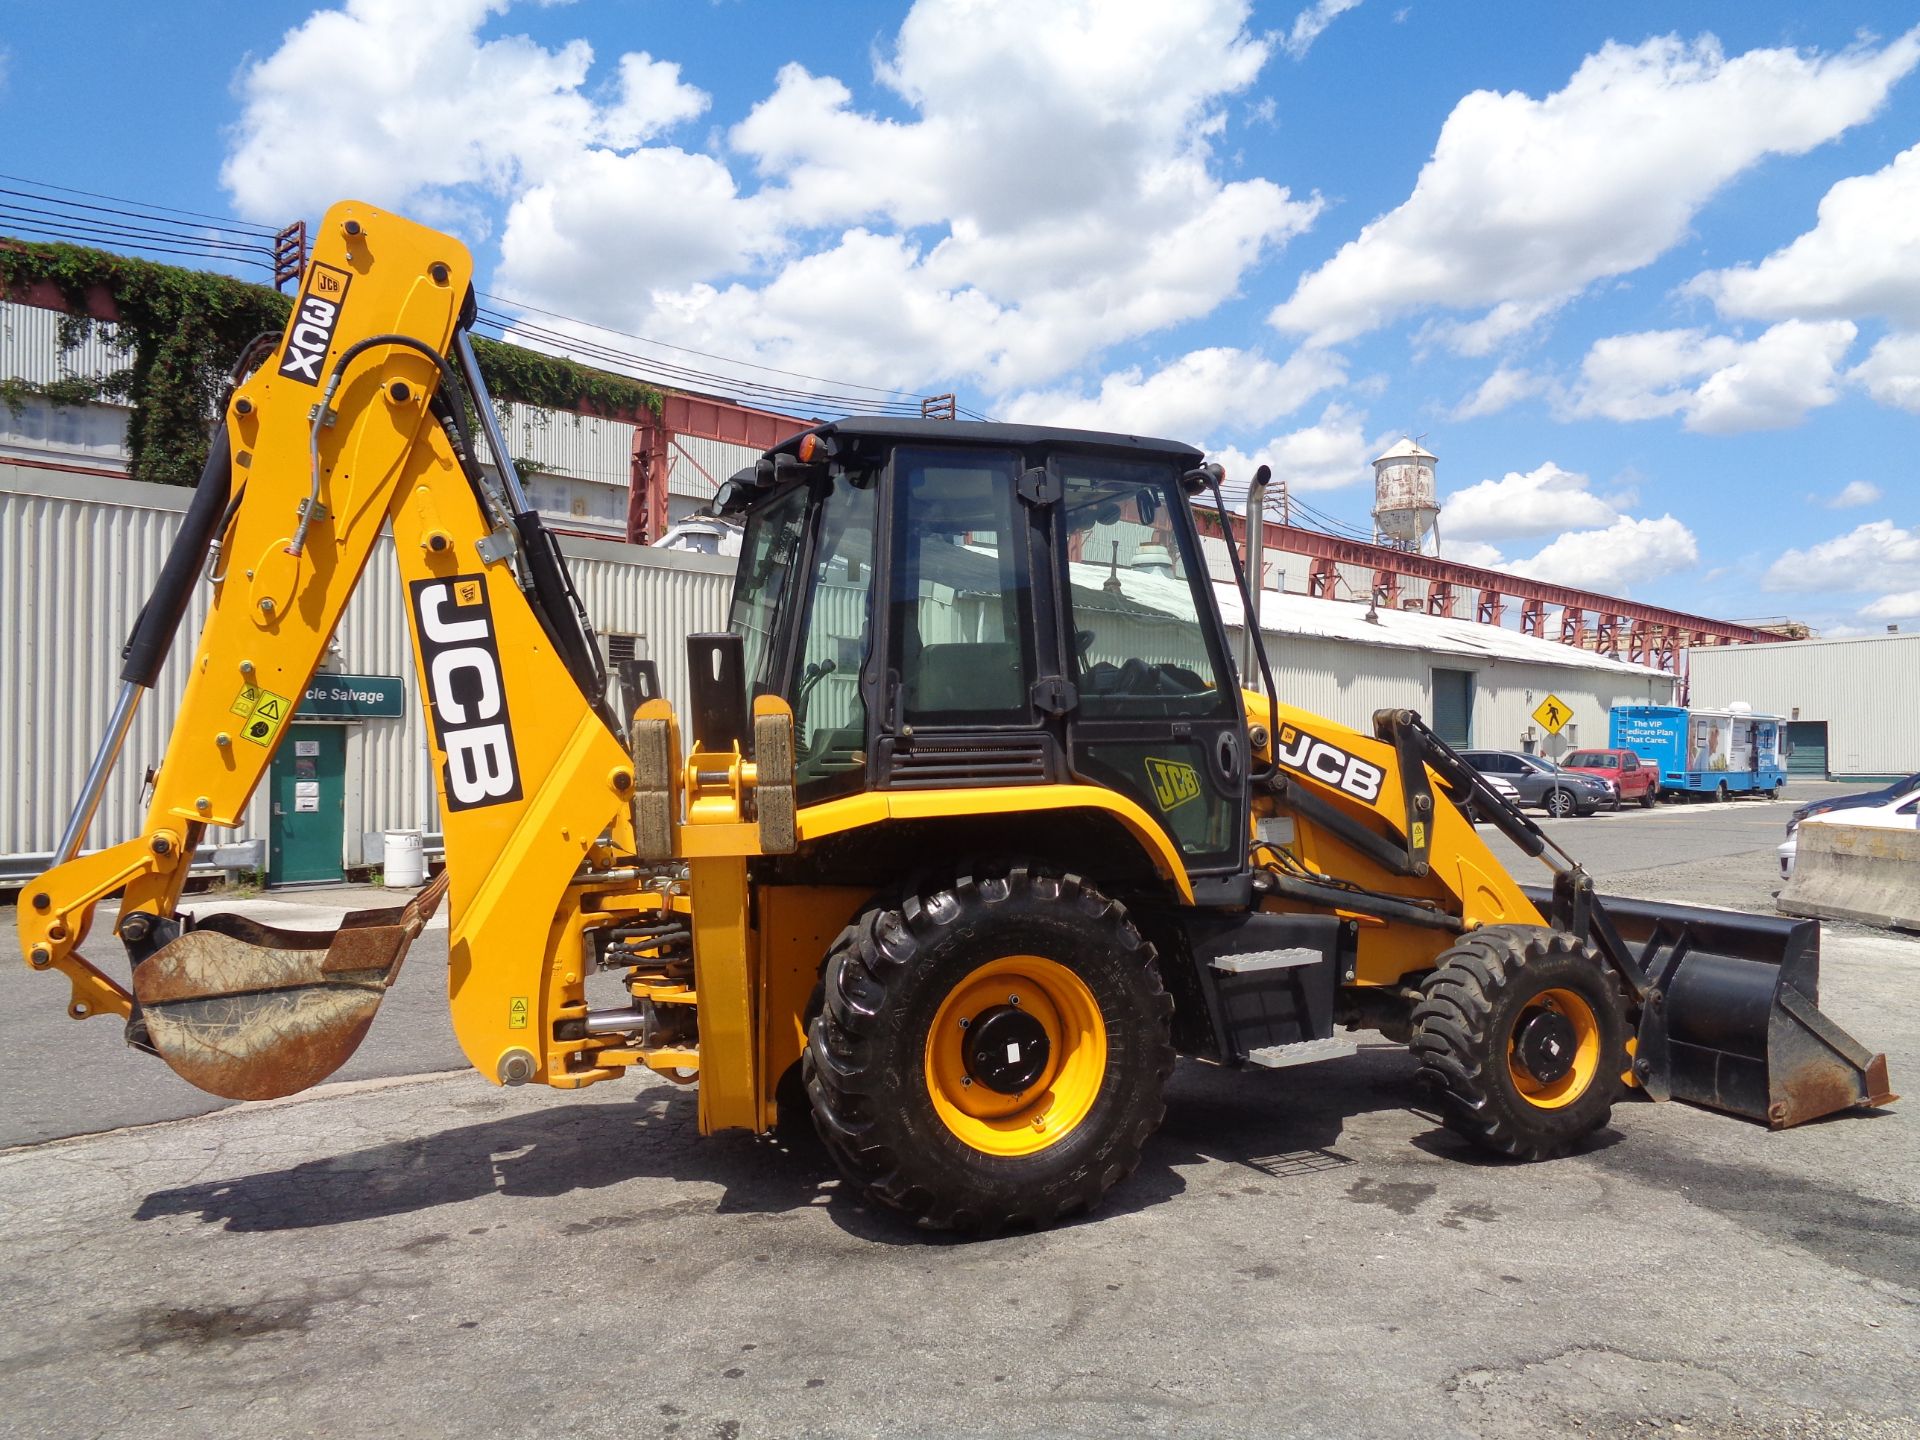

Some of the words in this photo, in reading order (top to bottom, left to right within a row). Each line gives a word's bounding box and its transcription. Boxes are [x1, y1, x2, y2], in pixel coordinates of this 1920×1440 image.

[320, 275, 339, 292] JCB
[281, 298, 336, 380] 3CX
[330, 688, 384, 704] Salvage
[419, 583, 514, 803] JCB
[1632, 720, 1648, 728] The
[1649, 720, 1663, 728] VIP
[1154, 763, 1197, 806] JCB
[1279, 735, 1381, 800] JCB
